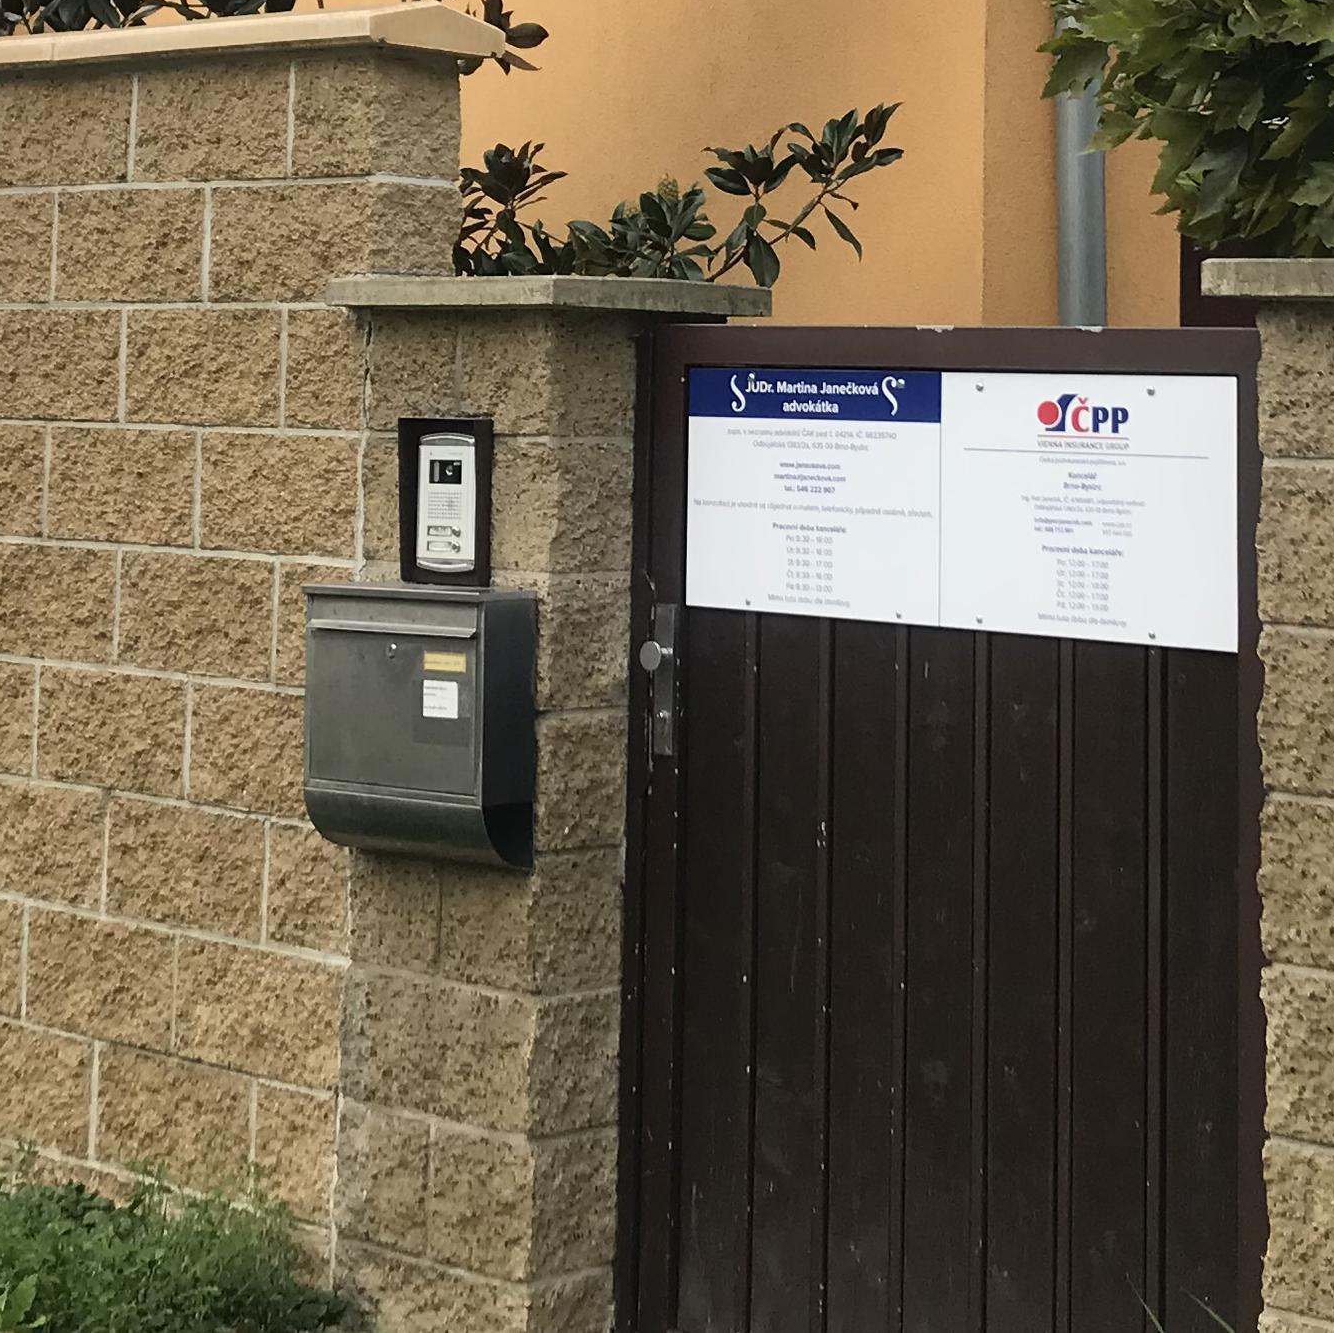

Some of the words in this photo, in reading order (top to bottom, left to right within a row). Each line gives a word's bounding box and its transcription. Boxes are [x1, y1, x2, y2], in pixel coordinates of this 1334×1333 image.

[777, 381, 817, 394] Martina
[819, 382, 879, 396] Janečková
[782, 400, 839, 414] advokátka
[1070, 397, 1129, 434] ČPP
